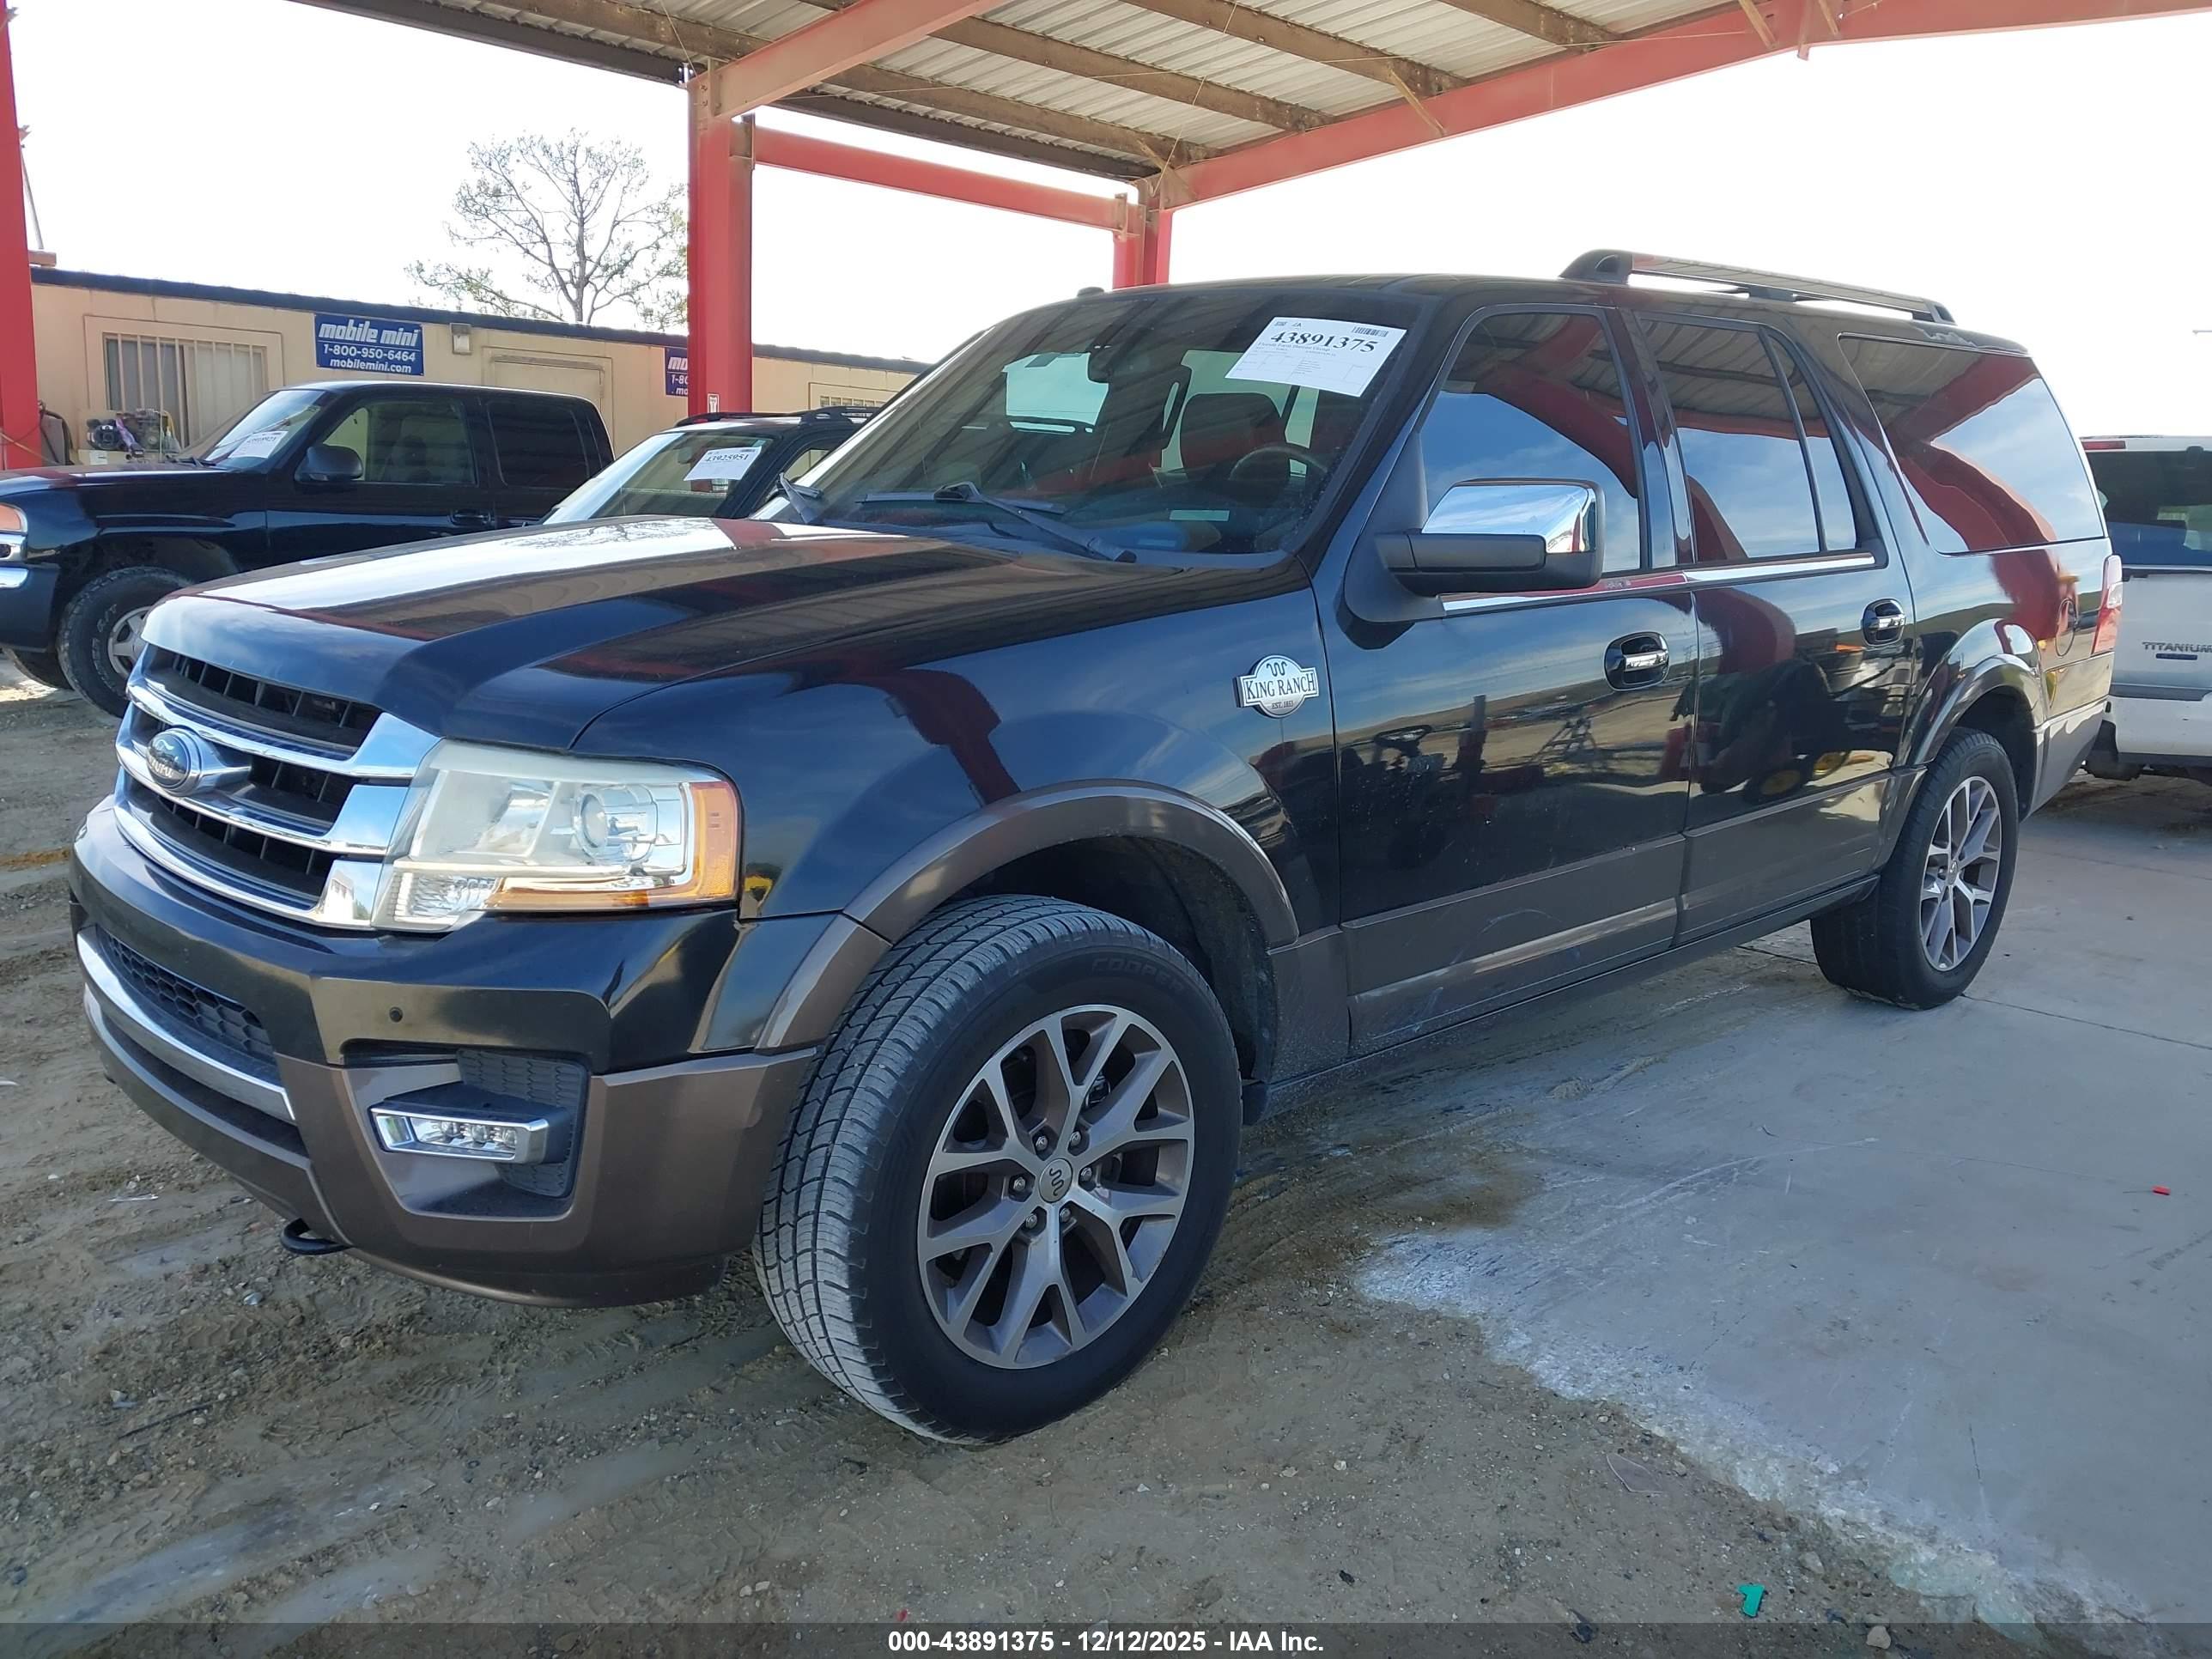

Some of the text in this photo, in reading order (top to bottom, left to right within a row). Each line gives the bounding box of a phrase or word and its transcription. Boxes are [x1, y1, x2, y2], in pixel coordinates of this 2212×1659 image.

[319, 319, 421, 346] mobile mini
[1270, 331, 1378, 353] 43891375
[324, 343, 416, 362] 1-800-950-6464
[330, 358, 411, 373] mobilemini.com
[1245, 672, 1316, 700] KING RANCH
